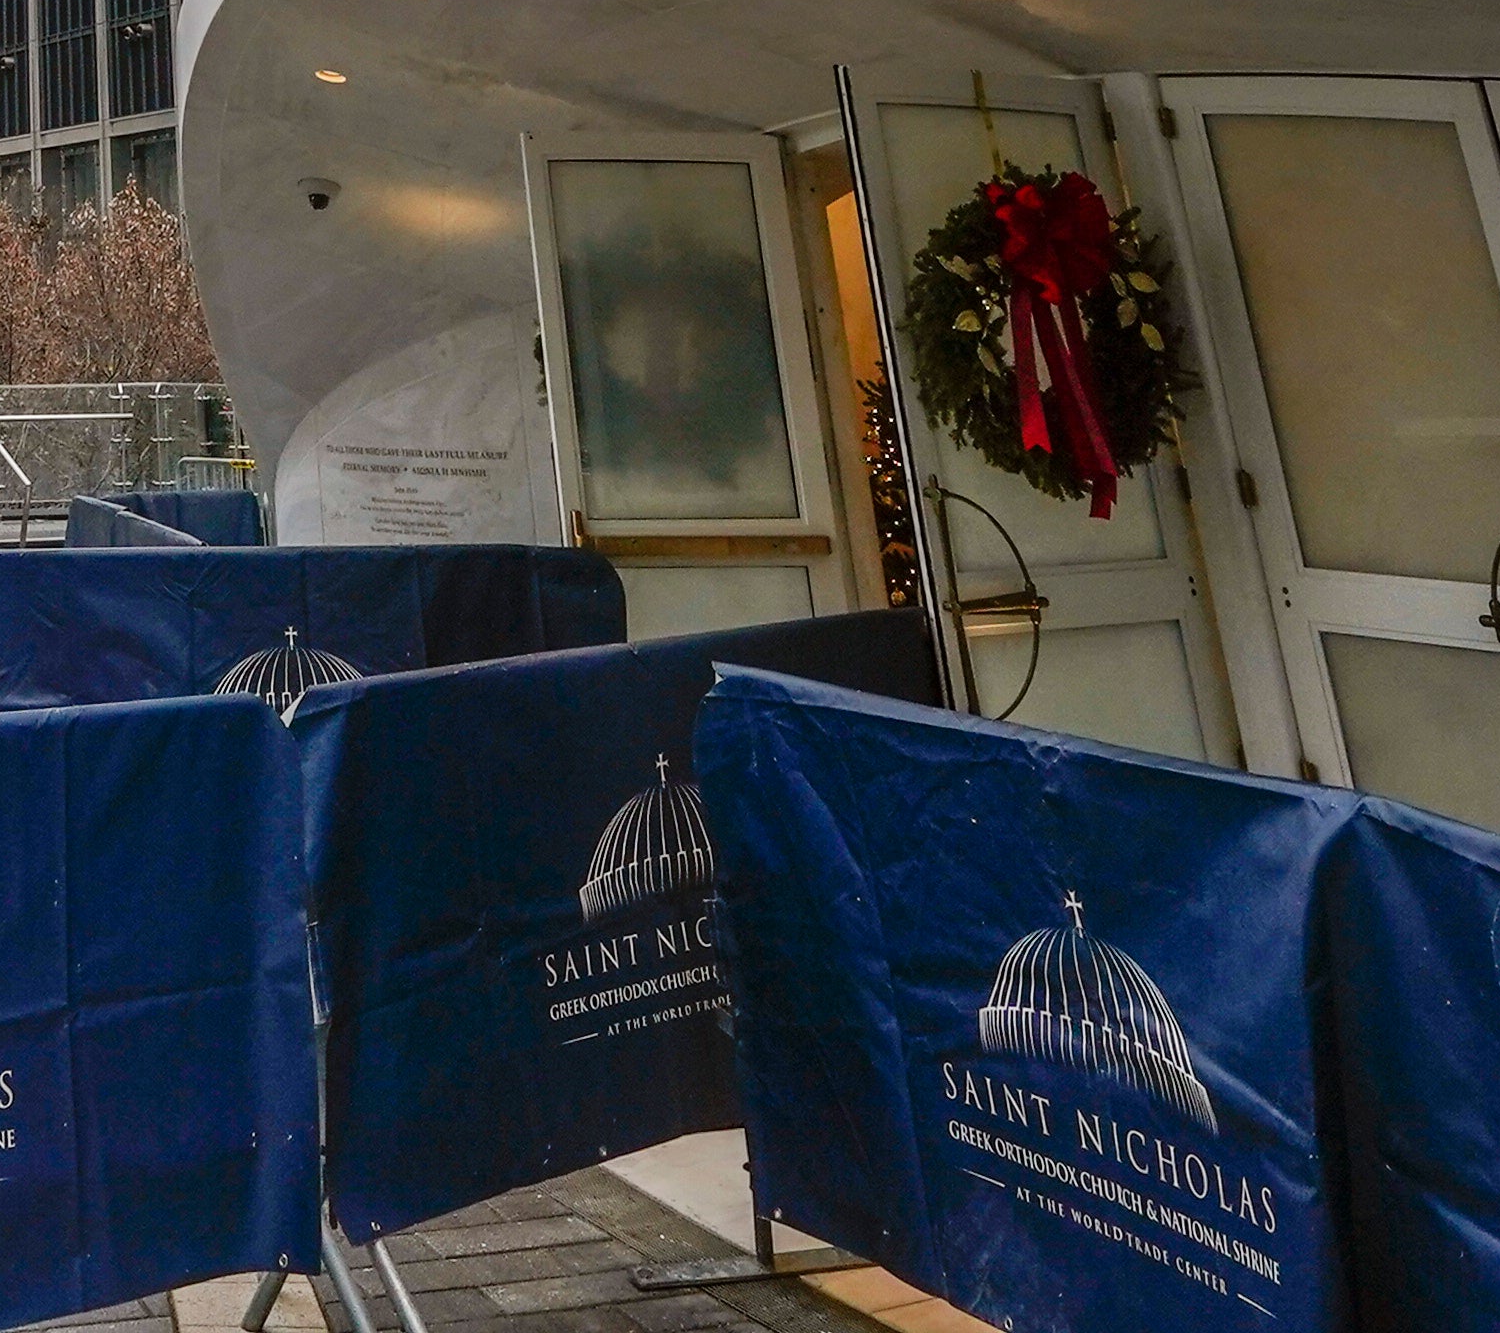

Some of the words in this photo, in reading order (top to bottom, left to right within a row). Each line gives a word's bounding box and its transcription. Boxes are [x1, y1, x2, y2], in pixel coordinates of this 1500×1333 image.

[545, 933, 639, 987] SAINT
[550, 995, 589, 1021] GREEK
[589, 978, 660, 1011] ORTHODOX
[659, 964, 711, 993] CHURCH
[607, 1022, 621, 1037] AT
[625, 1015, 648, 1032] THE
[652, 1004, 692, 1024] WORLD
[696, 993, 733, 1012] TRADE
[943, 1061, 1050, 1137] SAINT
[1075, 1108, 1277, 1234] NICHOLAS
[948, 1119, 993, 1151] GREEK
[995, 1138, 1079, 1188] ORTHODOX
[1080, 1171, 1142, 1215] CHURCH
[1146, 1199, 1159, 1221] &
[1160, 1204, 1232, 1258] NATIONAL
[1232, 1240, 1282, 1286] SHRINE
[1016, 1186, 1032, 1203] AT
[1037, 1195, 1066, 1218] THE
[1070, 1208, 1124, 1242] WORLD
[1125, 1232, 1170, 1266] TRADE
[1175, 1256, 1228, 1296] CENTER
